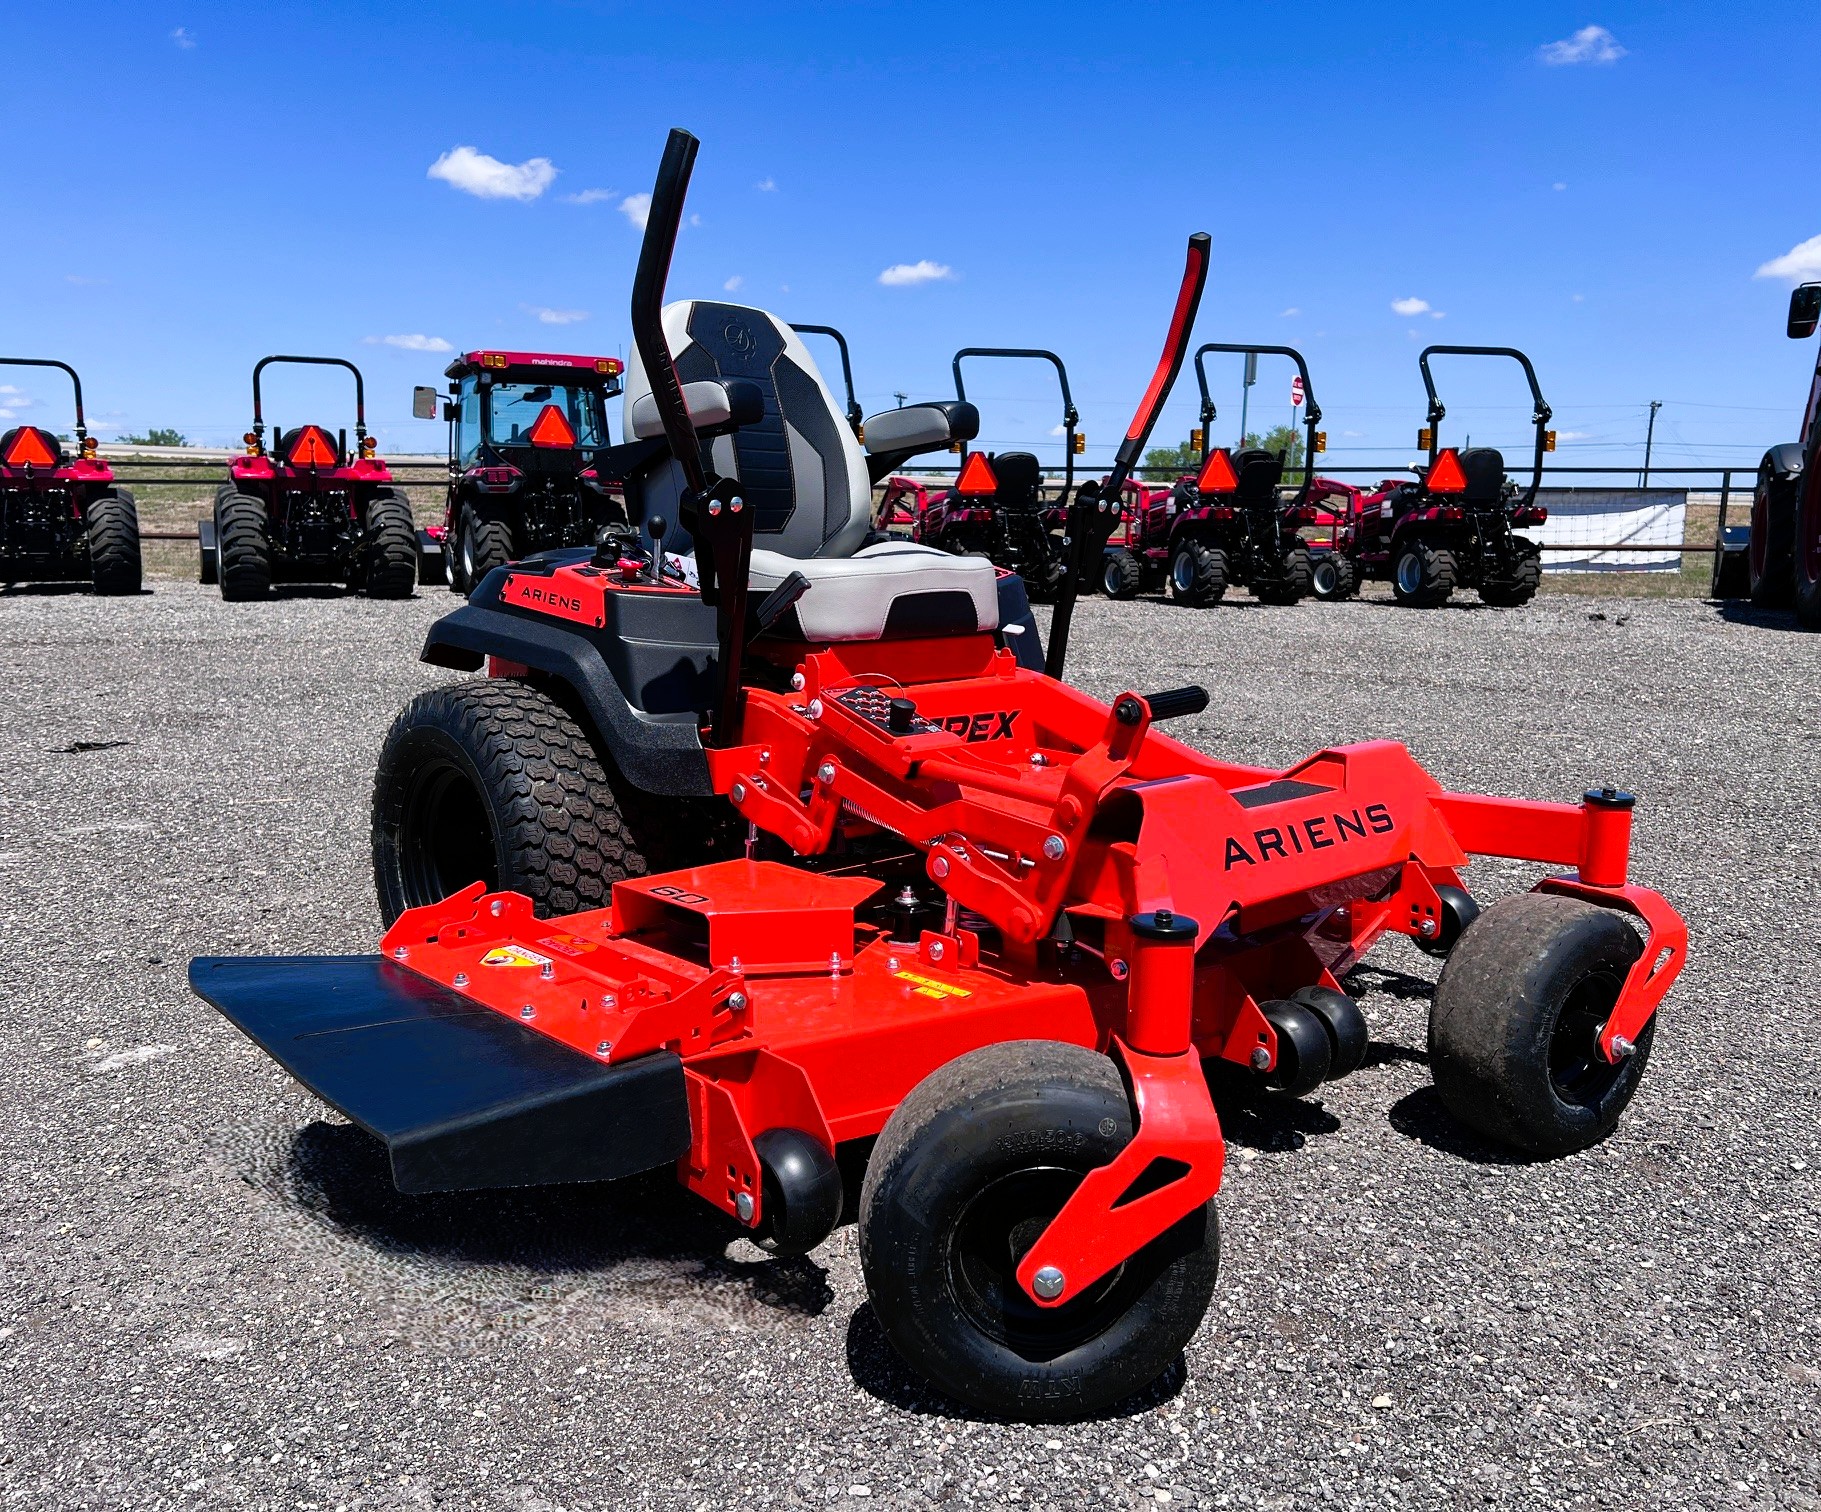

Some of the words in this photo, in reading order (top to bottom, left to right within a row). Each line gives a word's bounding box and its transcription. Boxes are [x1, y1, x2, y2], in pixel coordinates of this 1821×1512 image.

[531, 358, 573, 367] mahindra
[521, 586, 581, 612] ARIENS
[1224, 803, 1394, 872] ARIENS
[649, 886, 709, 903] 60
